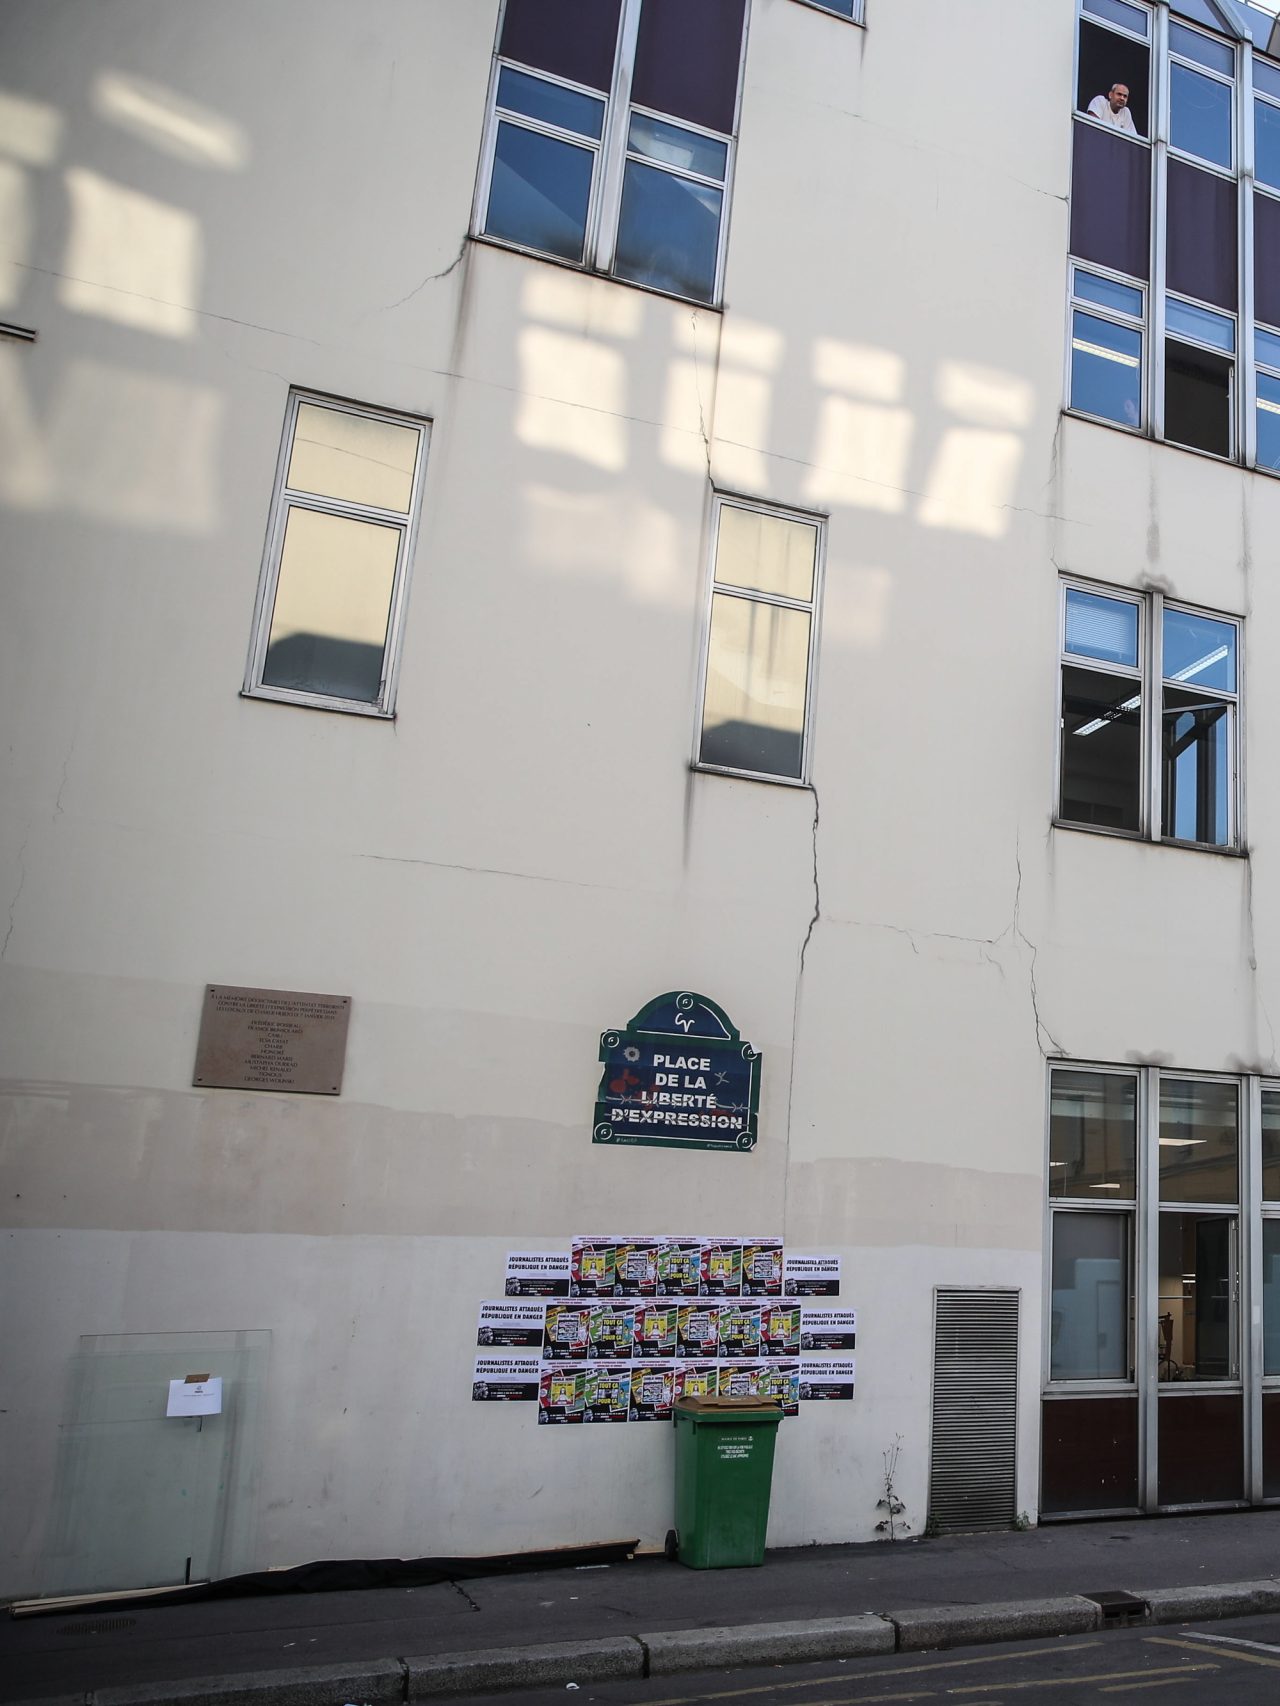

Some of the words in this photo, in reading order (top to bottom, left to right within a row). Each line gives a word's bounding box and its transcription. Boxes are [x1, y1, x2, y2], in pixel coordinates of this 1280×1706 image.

[653, 1054, 711, 1071] PLACE
[655, 1073, 679, 1087] DE
[684, 1075, 707, 1090] LA
[641, 1091, 717, 1109] LIBERTÉ
[611, 1108, 743, 1130] D'EXPRESSION
[481, 1312, 513, 1320] RÉPUBLIQUE
